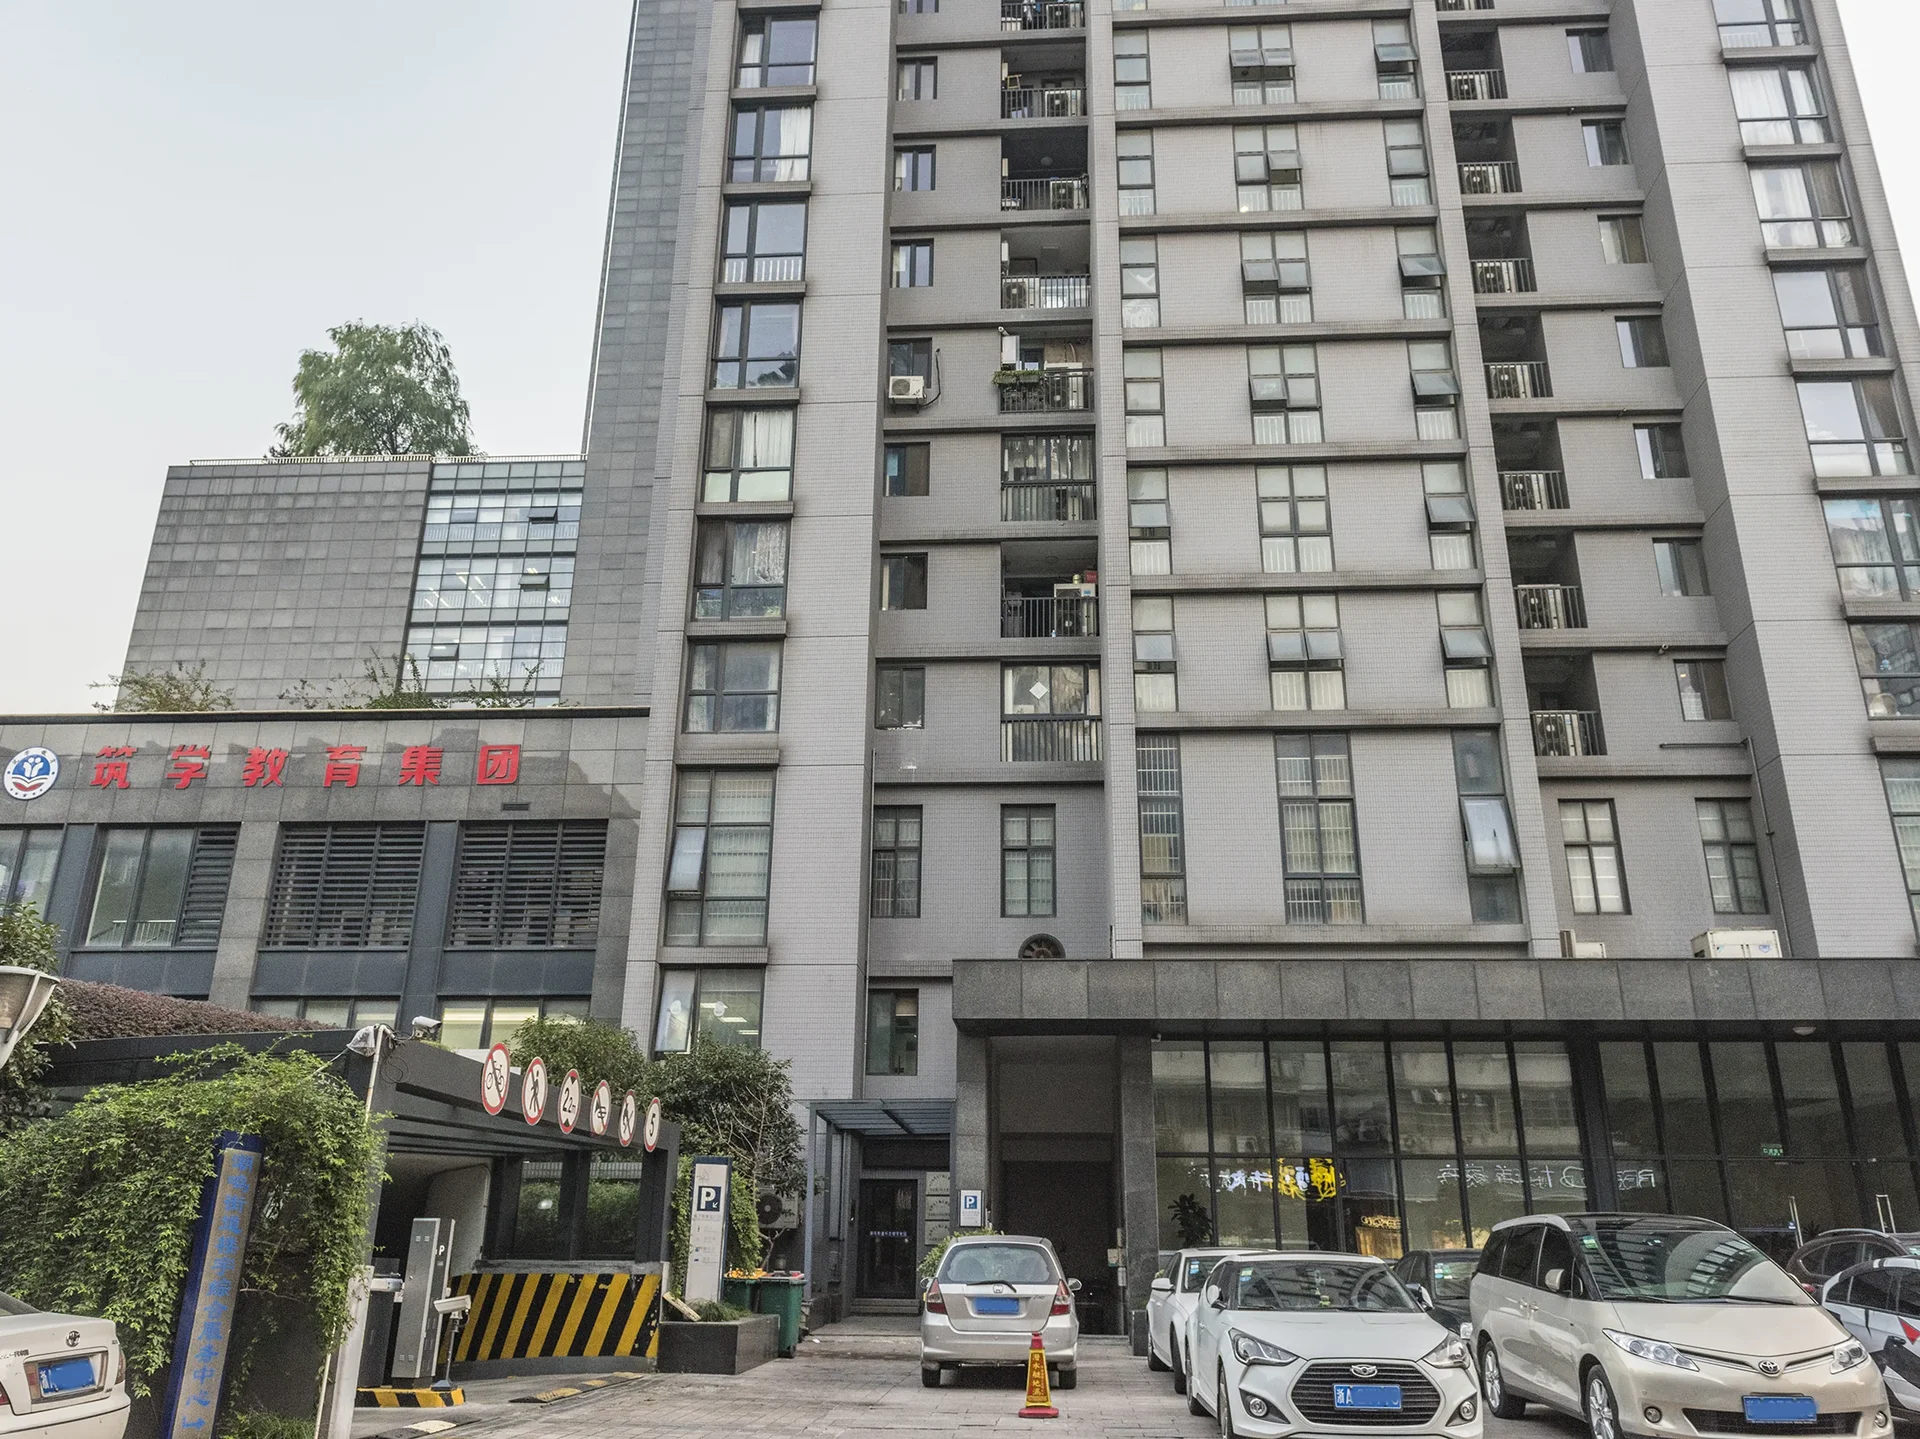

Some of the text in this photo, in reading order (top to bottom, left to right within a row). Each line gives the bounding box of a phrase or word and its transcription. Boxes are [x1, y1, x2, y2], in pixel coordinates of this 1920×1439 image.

[91, 743, 522, 789] 筑学教育集团
[650, 1113, 656, 1137] 5
[700, 1187, 716, 1209] P
[966, 1196, 975, 1209] P
